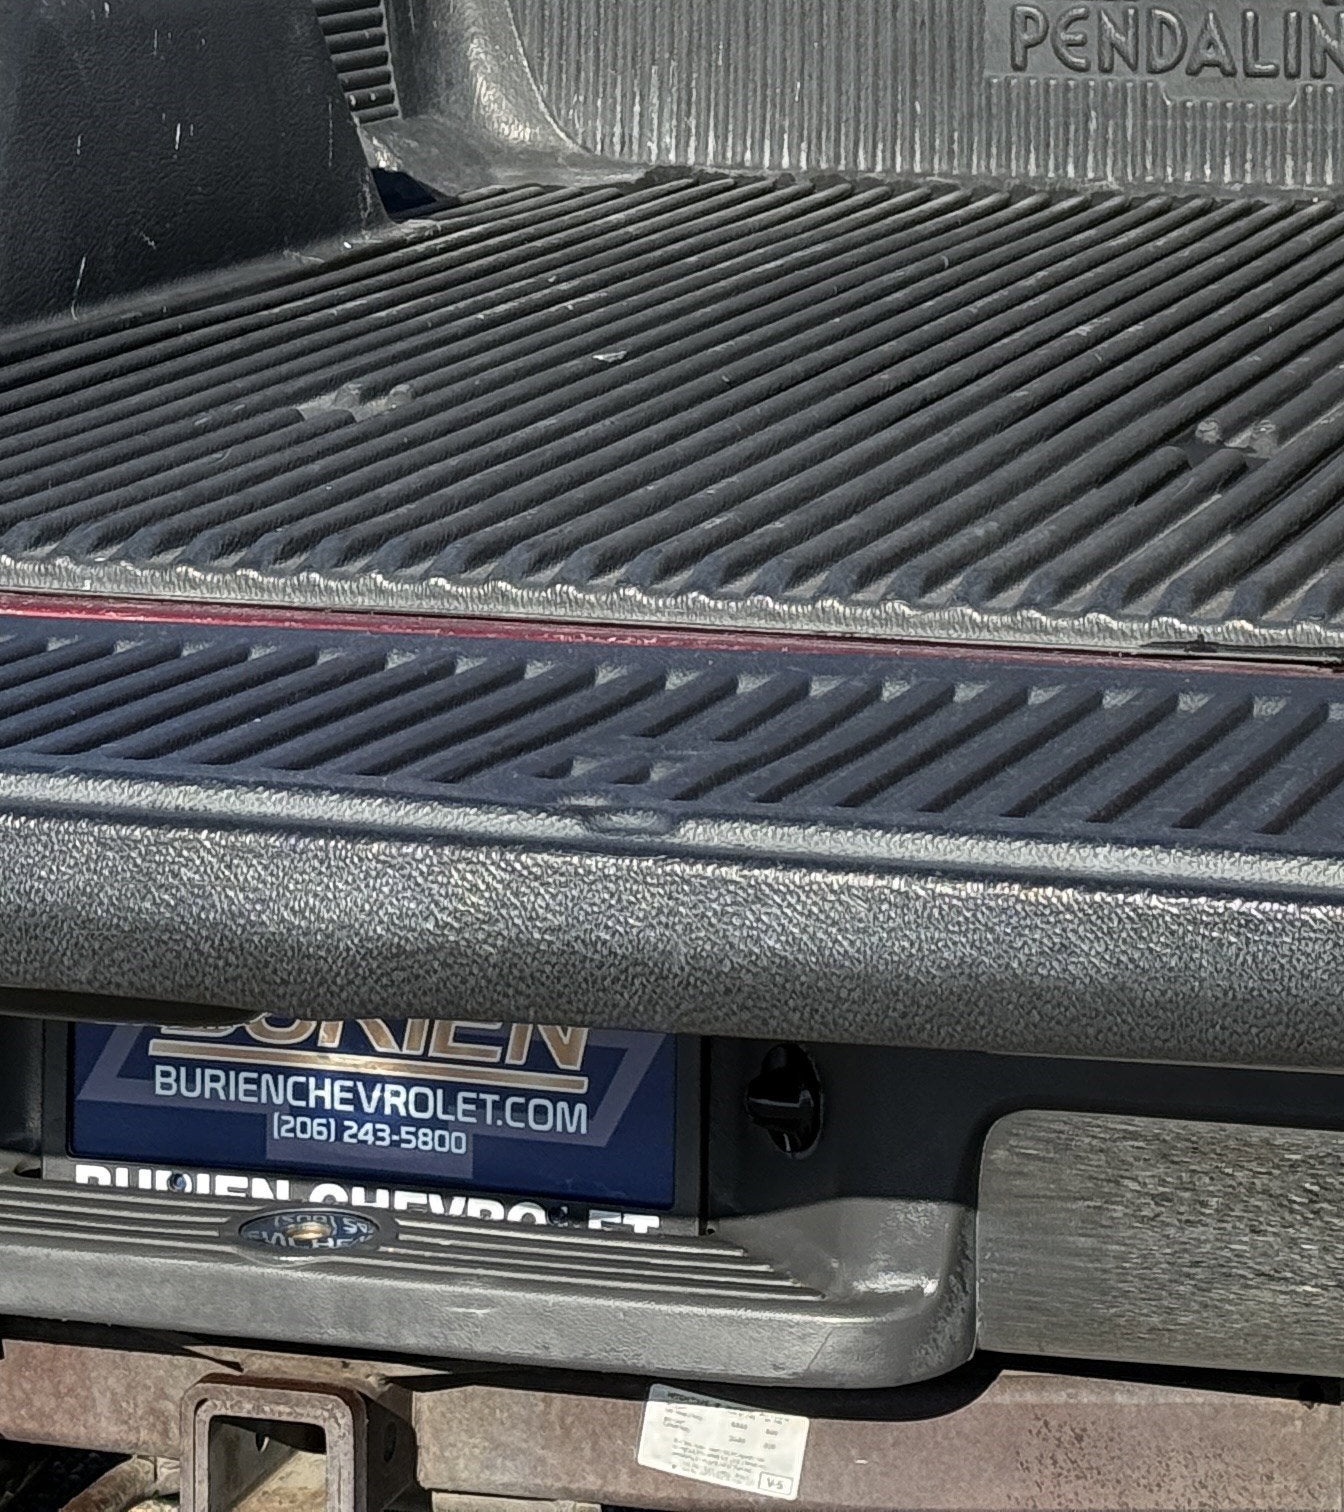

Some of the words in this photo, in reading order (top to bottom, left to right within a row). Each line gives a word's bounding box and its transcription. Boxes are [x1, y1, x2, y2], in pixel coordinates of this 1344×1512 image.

[154, 1064, 589, 1135] BURIENCHEVROLET.COM
[273, 1111, 337, 1143] (206)
[343, 1120, 468, 1155] 243-5800
